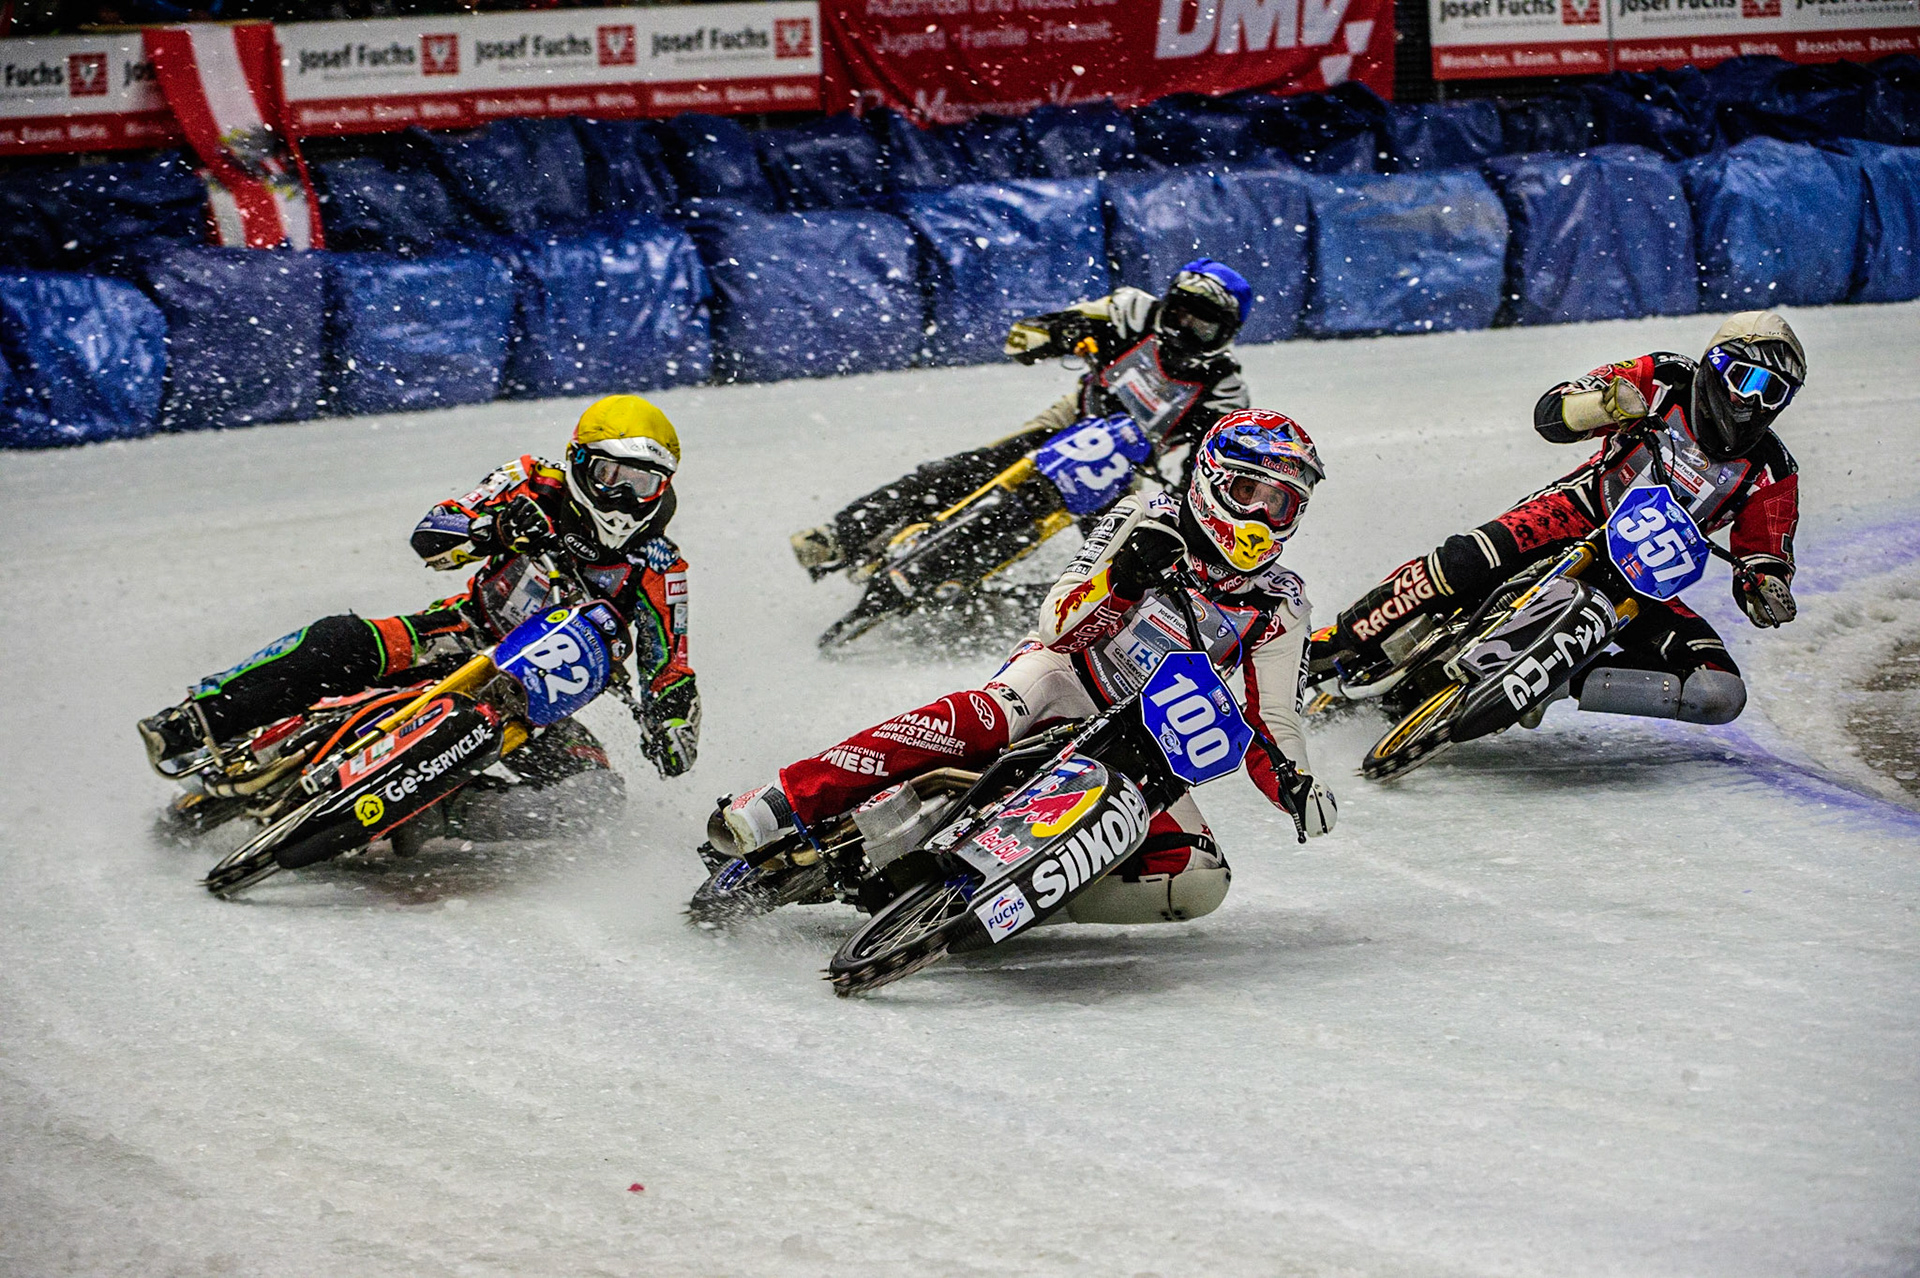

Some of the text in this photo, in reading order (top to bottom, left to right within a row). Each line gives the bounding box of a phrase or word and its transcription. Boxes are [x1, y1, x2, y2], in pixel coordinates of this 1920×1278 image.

[299, 42, 352, 75] Josef
[357, 41, 415, 67] Fuchs
[475, 33, 592, 65] Josef Fuchs
[652, 26, 769, 57] Josef Fuchs
[4, 62, 65, 88] Fuchs
[1053, 427, 1130, 491] 93
[1261, 456, 1300, 480] Red Bull
[1616, 507, 1696, 583] 357
[1262, 570, 1304, 607] FUCHS
[1393, 559, 1425, 597] ICE
[1158, 608, 1174, 621] Josef
[1352, 580, 1437, 642] RACING
[521, 633, 590, 704] 82
[1089, 645, 1122, 701] Landesgruppe
[872, 730, 891, 740] BAD
[879, 722, 967, 750] HINTSTEINER
[901, 713, 949, 735] MAN
[1149, 673, 1230, 769] 100
[820, 749, 889, 777] MIESL
[973, 825, 1034, 864] Red Bull
[987, 898, 1025, 930] FUCHS
